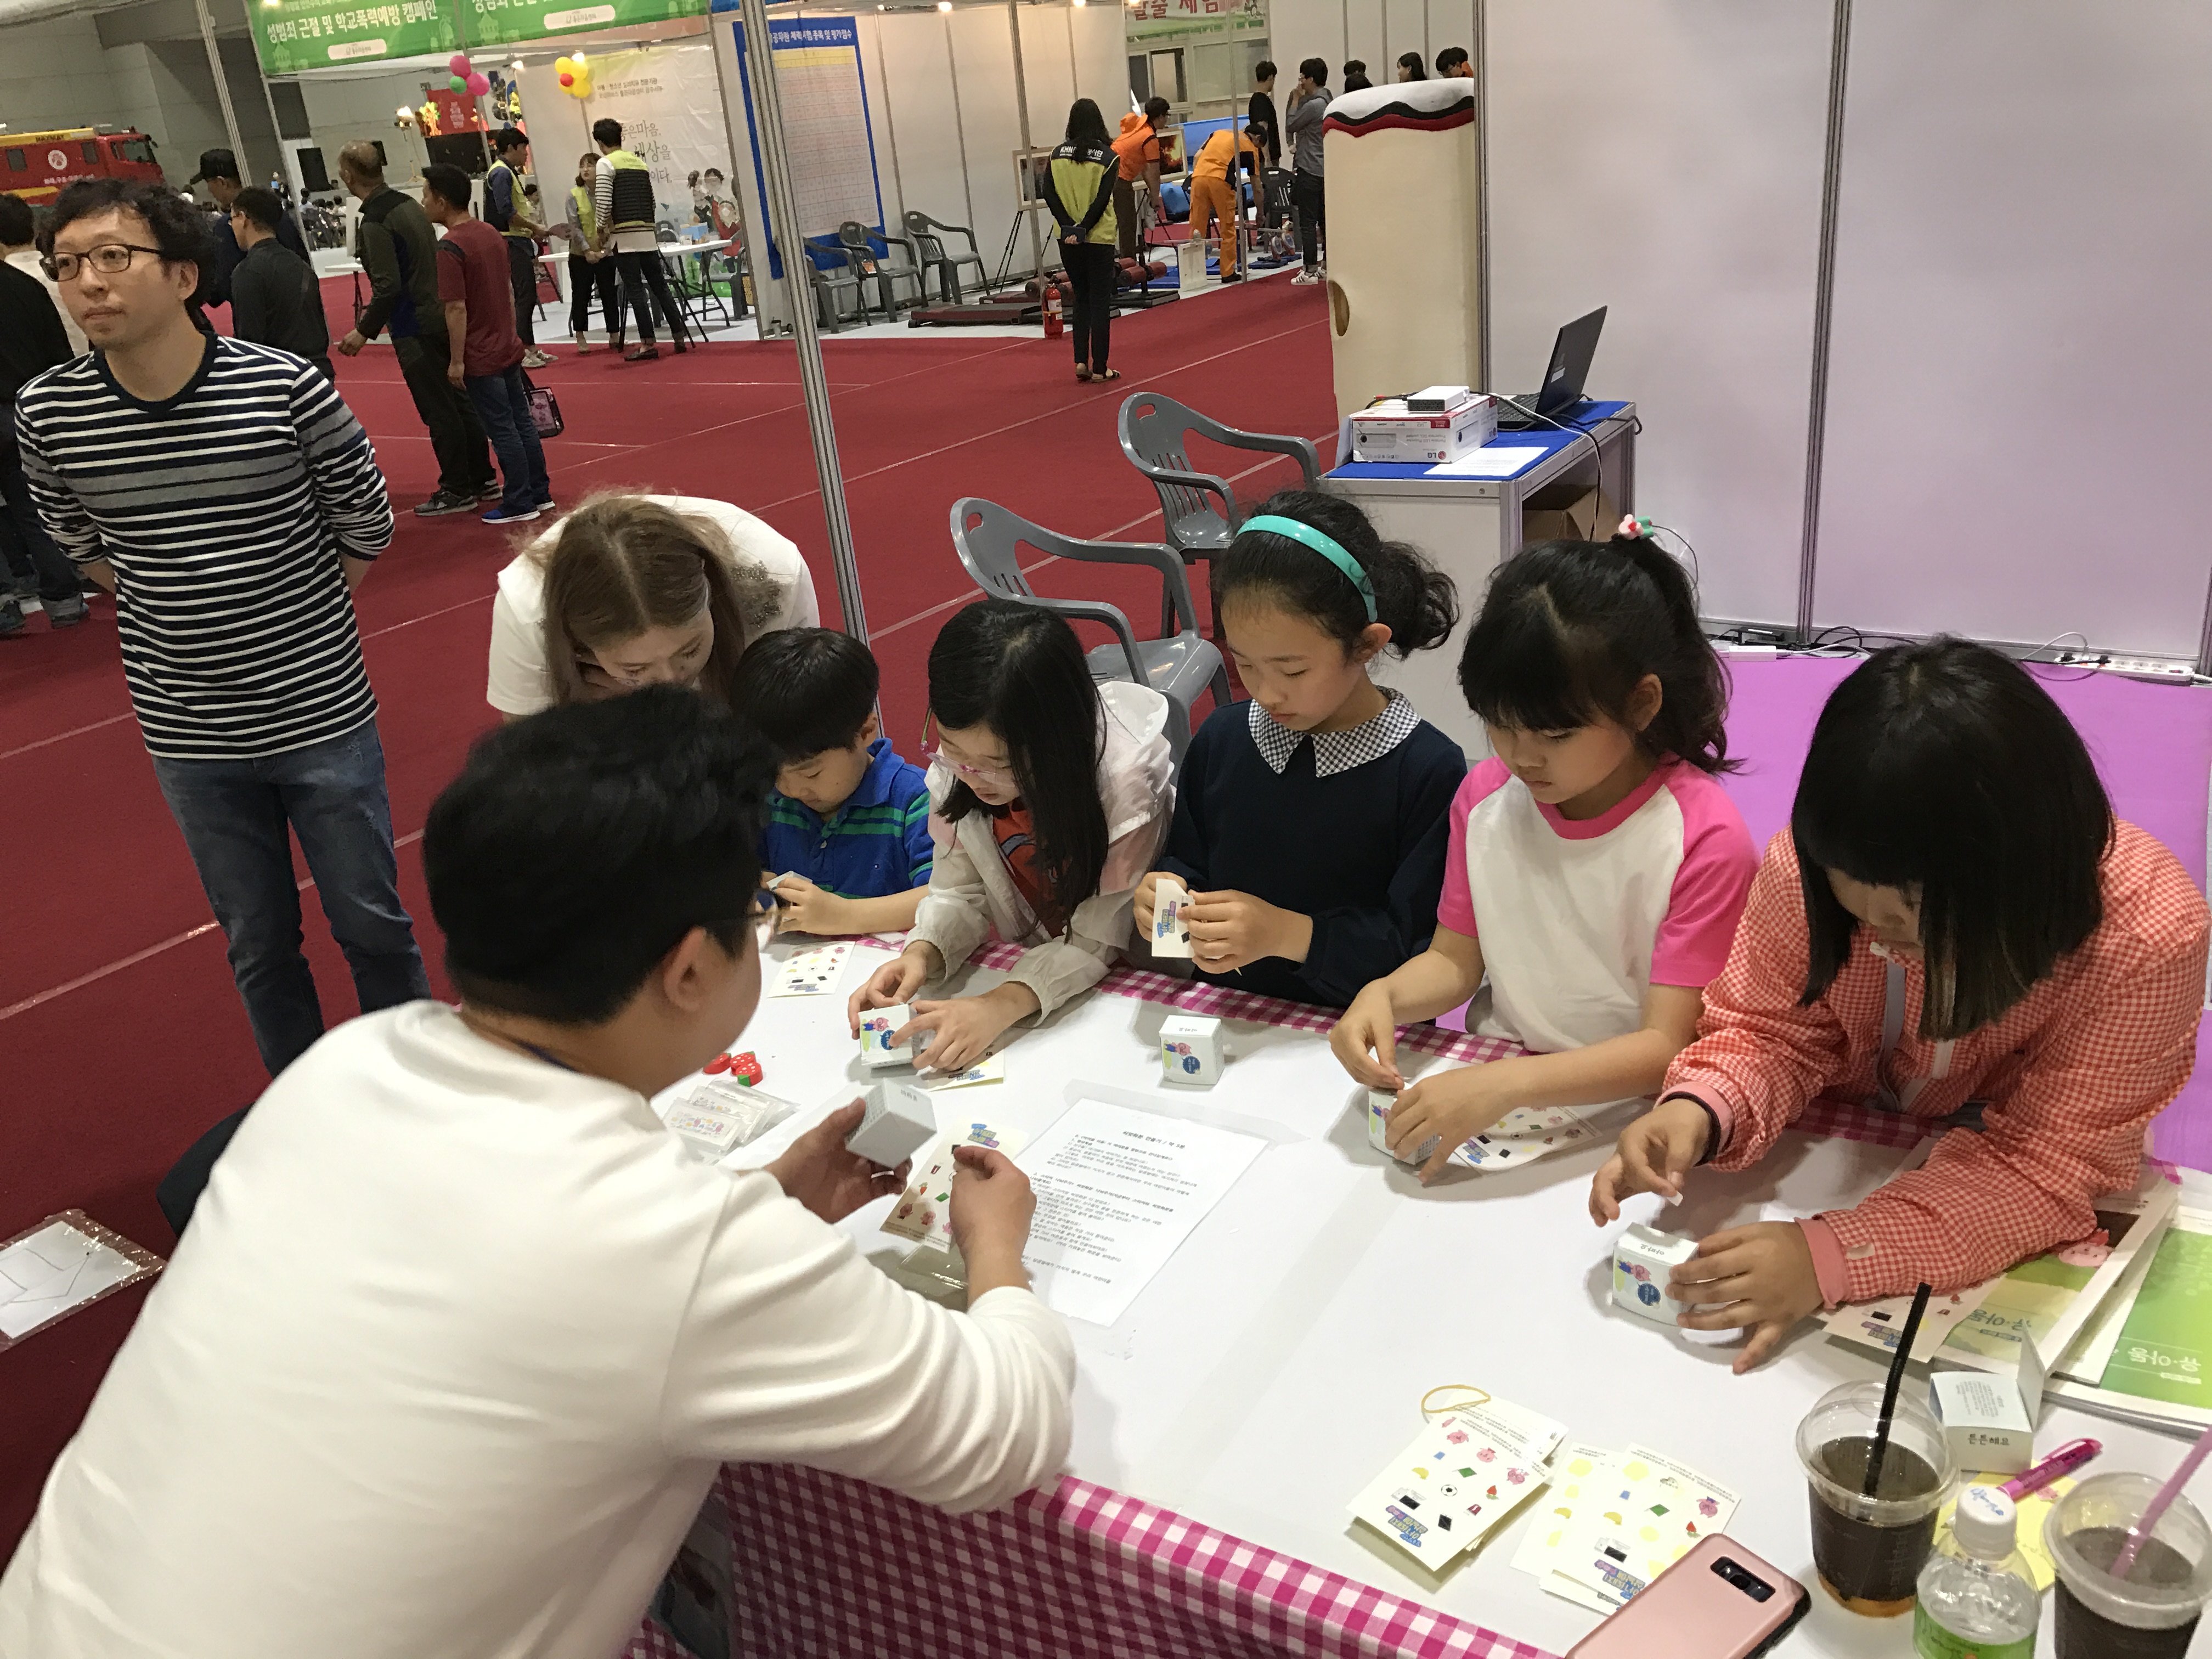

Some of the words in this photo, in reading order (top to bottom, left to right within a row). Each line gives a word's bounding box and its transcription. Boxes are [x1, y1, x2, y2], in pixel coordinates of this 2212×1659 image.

[267, 21, 297, 43] 성범죄
[299, 16, 321, 38] 근절
[322, 15, 334, 35] 및
[335, 5, 400, 33] 학교폭력예방
[402, 0, 438, 23] 캠페인
[769, 31, 789, 43] 공무원
[1640, 1244, 1664, 1255] 아파요
[2128, 1347, 2202, 1373] 유·아동
[1967, 1433, 2010, 1446] 튼튼해요
